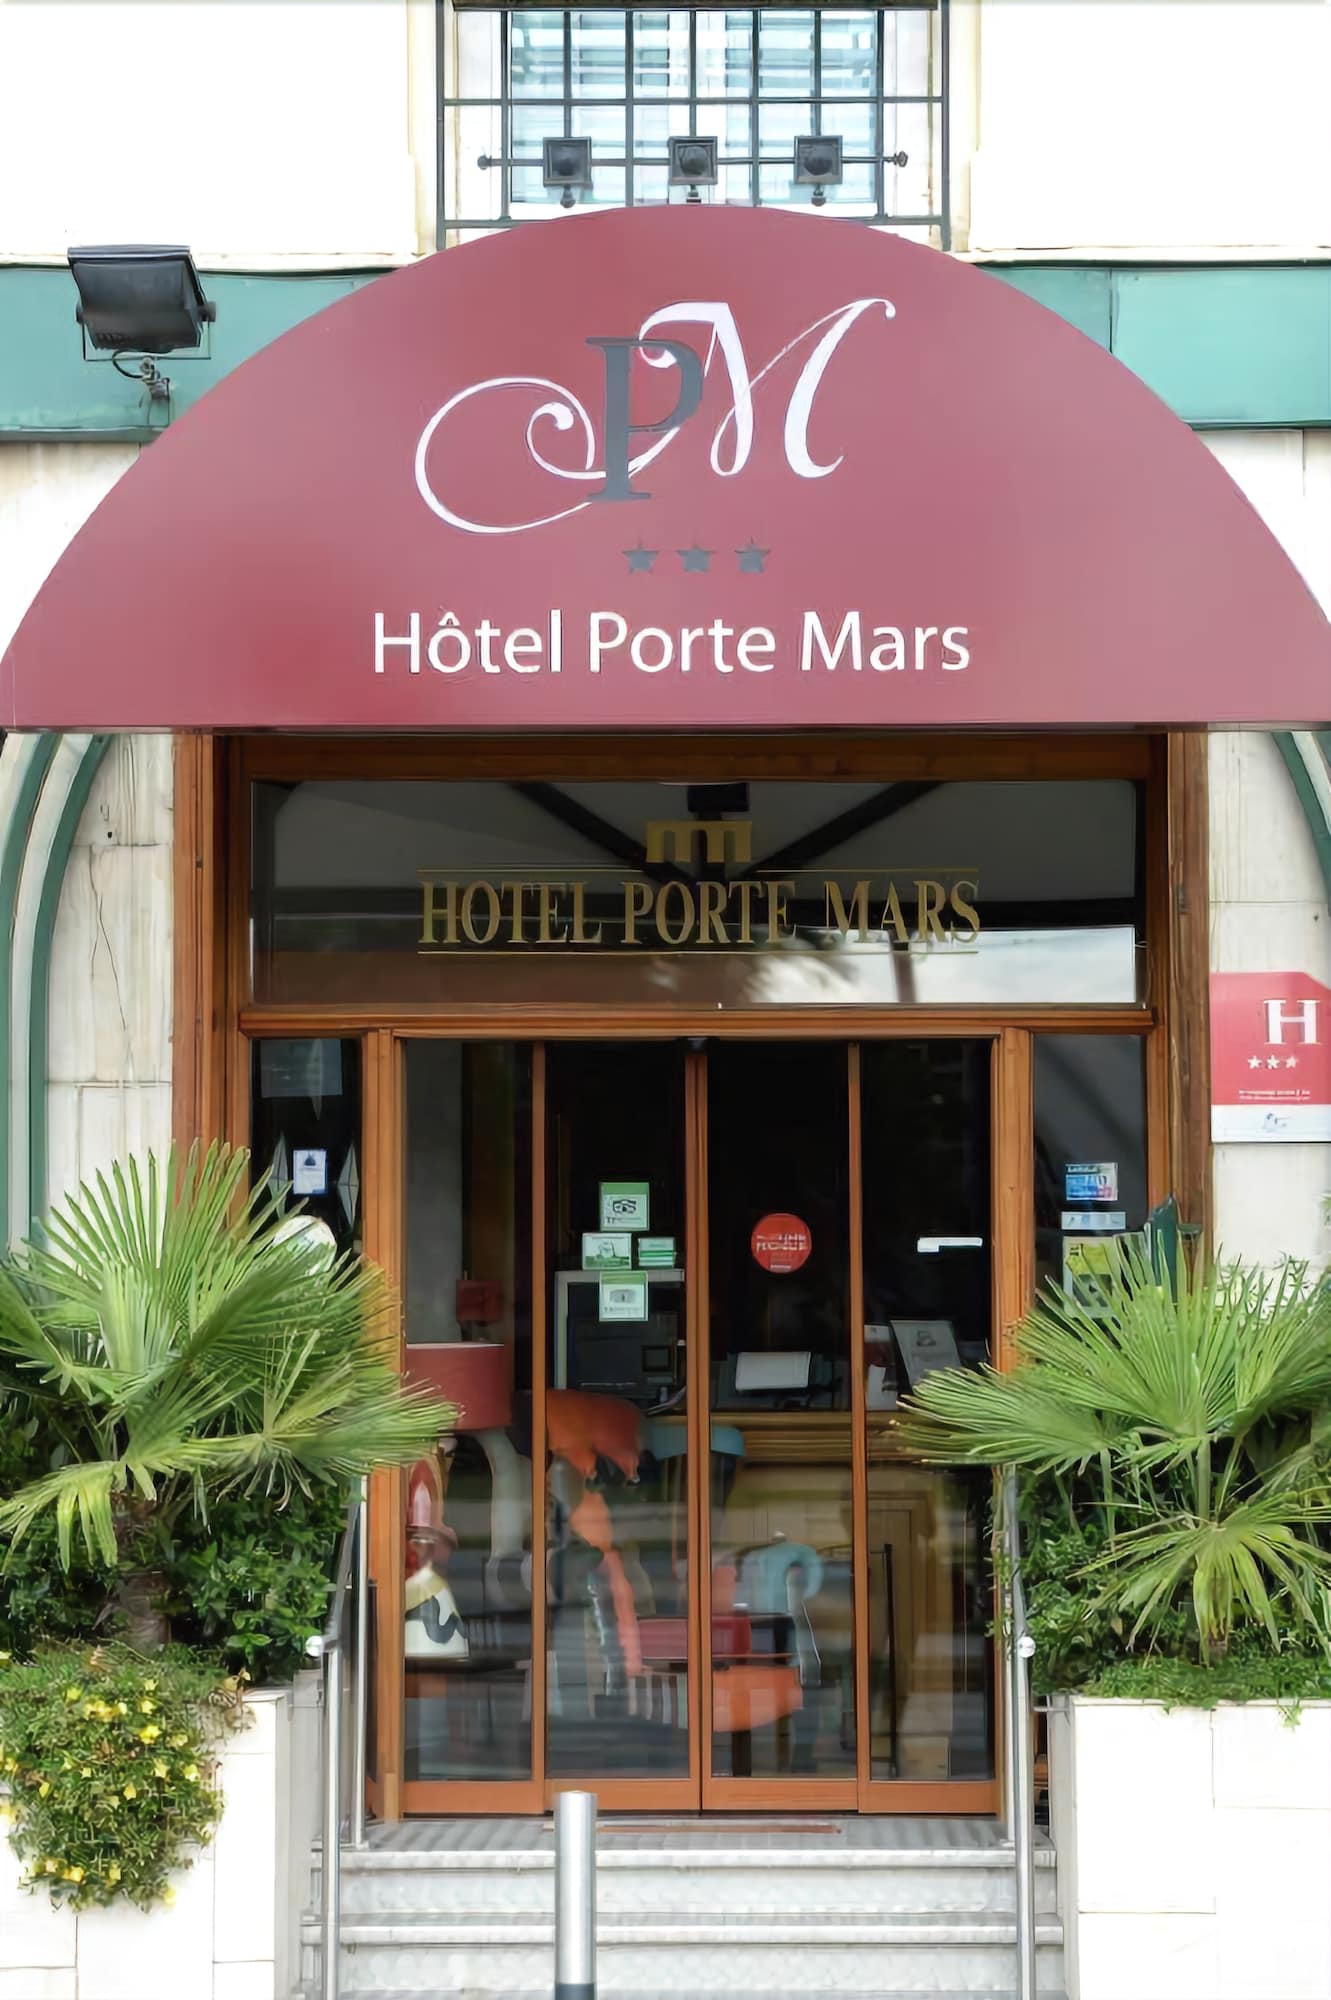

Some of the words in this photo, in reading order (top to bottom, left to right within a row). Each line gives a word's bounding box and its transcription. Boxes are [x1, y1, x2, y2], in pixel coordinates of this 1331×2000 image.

[373, 608, 562, 674] Hôtel
[588, 610, 776, 673] Porte
[801, 610, 971, 673] Mars
[418, 879, 602, 945] HOTEL
[620, 879, 797, 945] PORTE
[823, 879, 980, 945] MARS
[1263, 999, 1322, 1045] H
